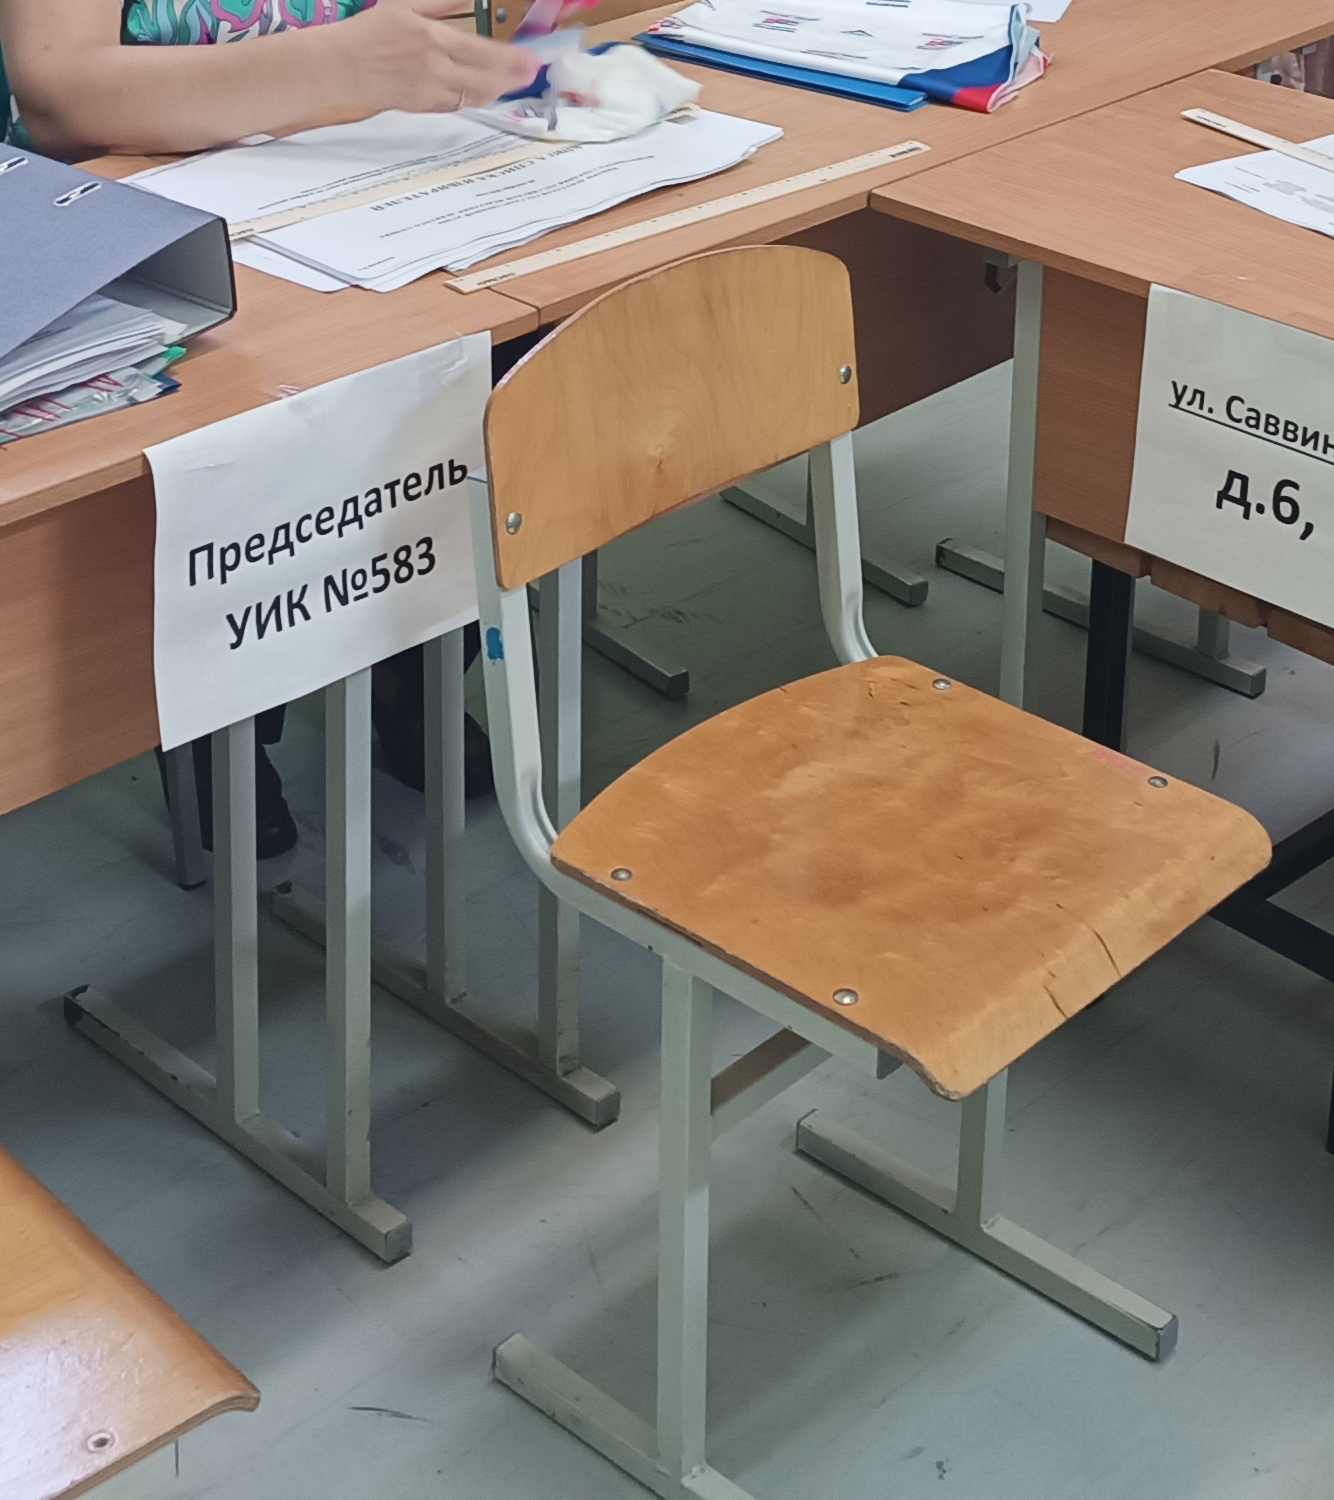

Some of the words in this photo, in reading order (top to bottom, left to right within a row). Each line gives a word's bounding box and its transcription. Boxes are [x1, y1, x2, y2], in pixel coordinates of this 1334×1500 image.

[1170, 381, 1214, 414] ул.
[188, 458, 468, 587] Председатель
[1215, 469, 1314, 541] д.6,
[225, 584, 311, 650] УИК
[323, 537, 436, 612] №583
